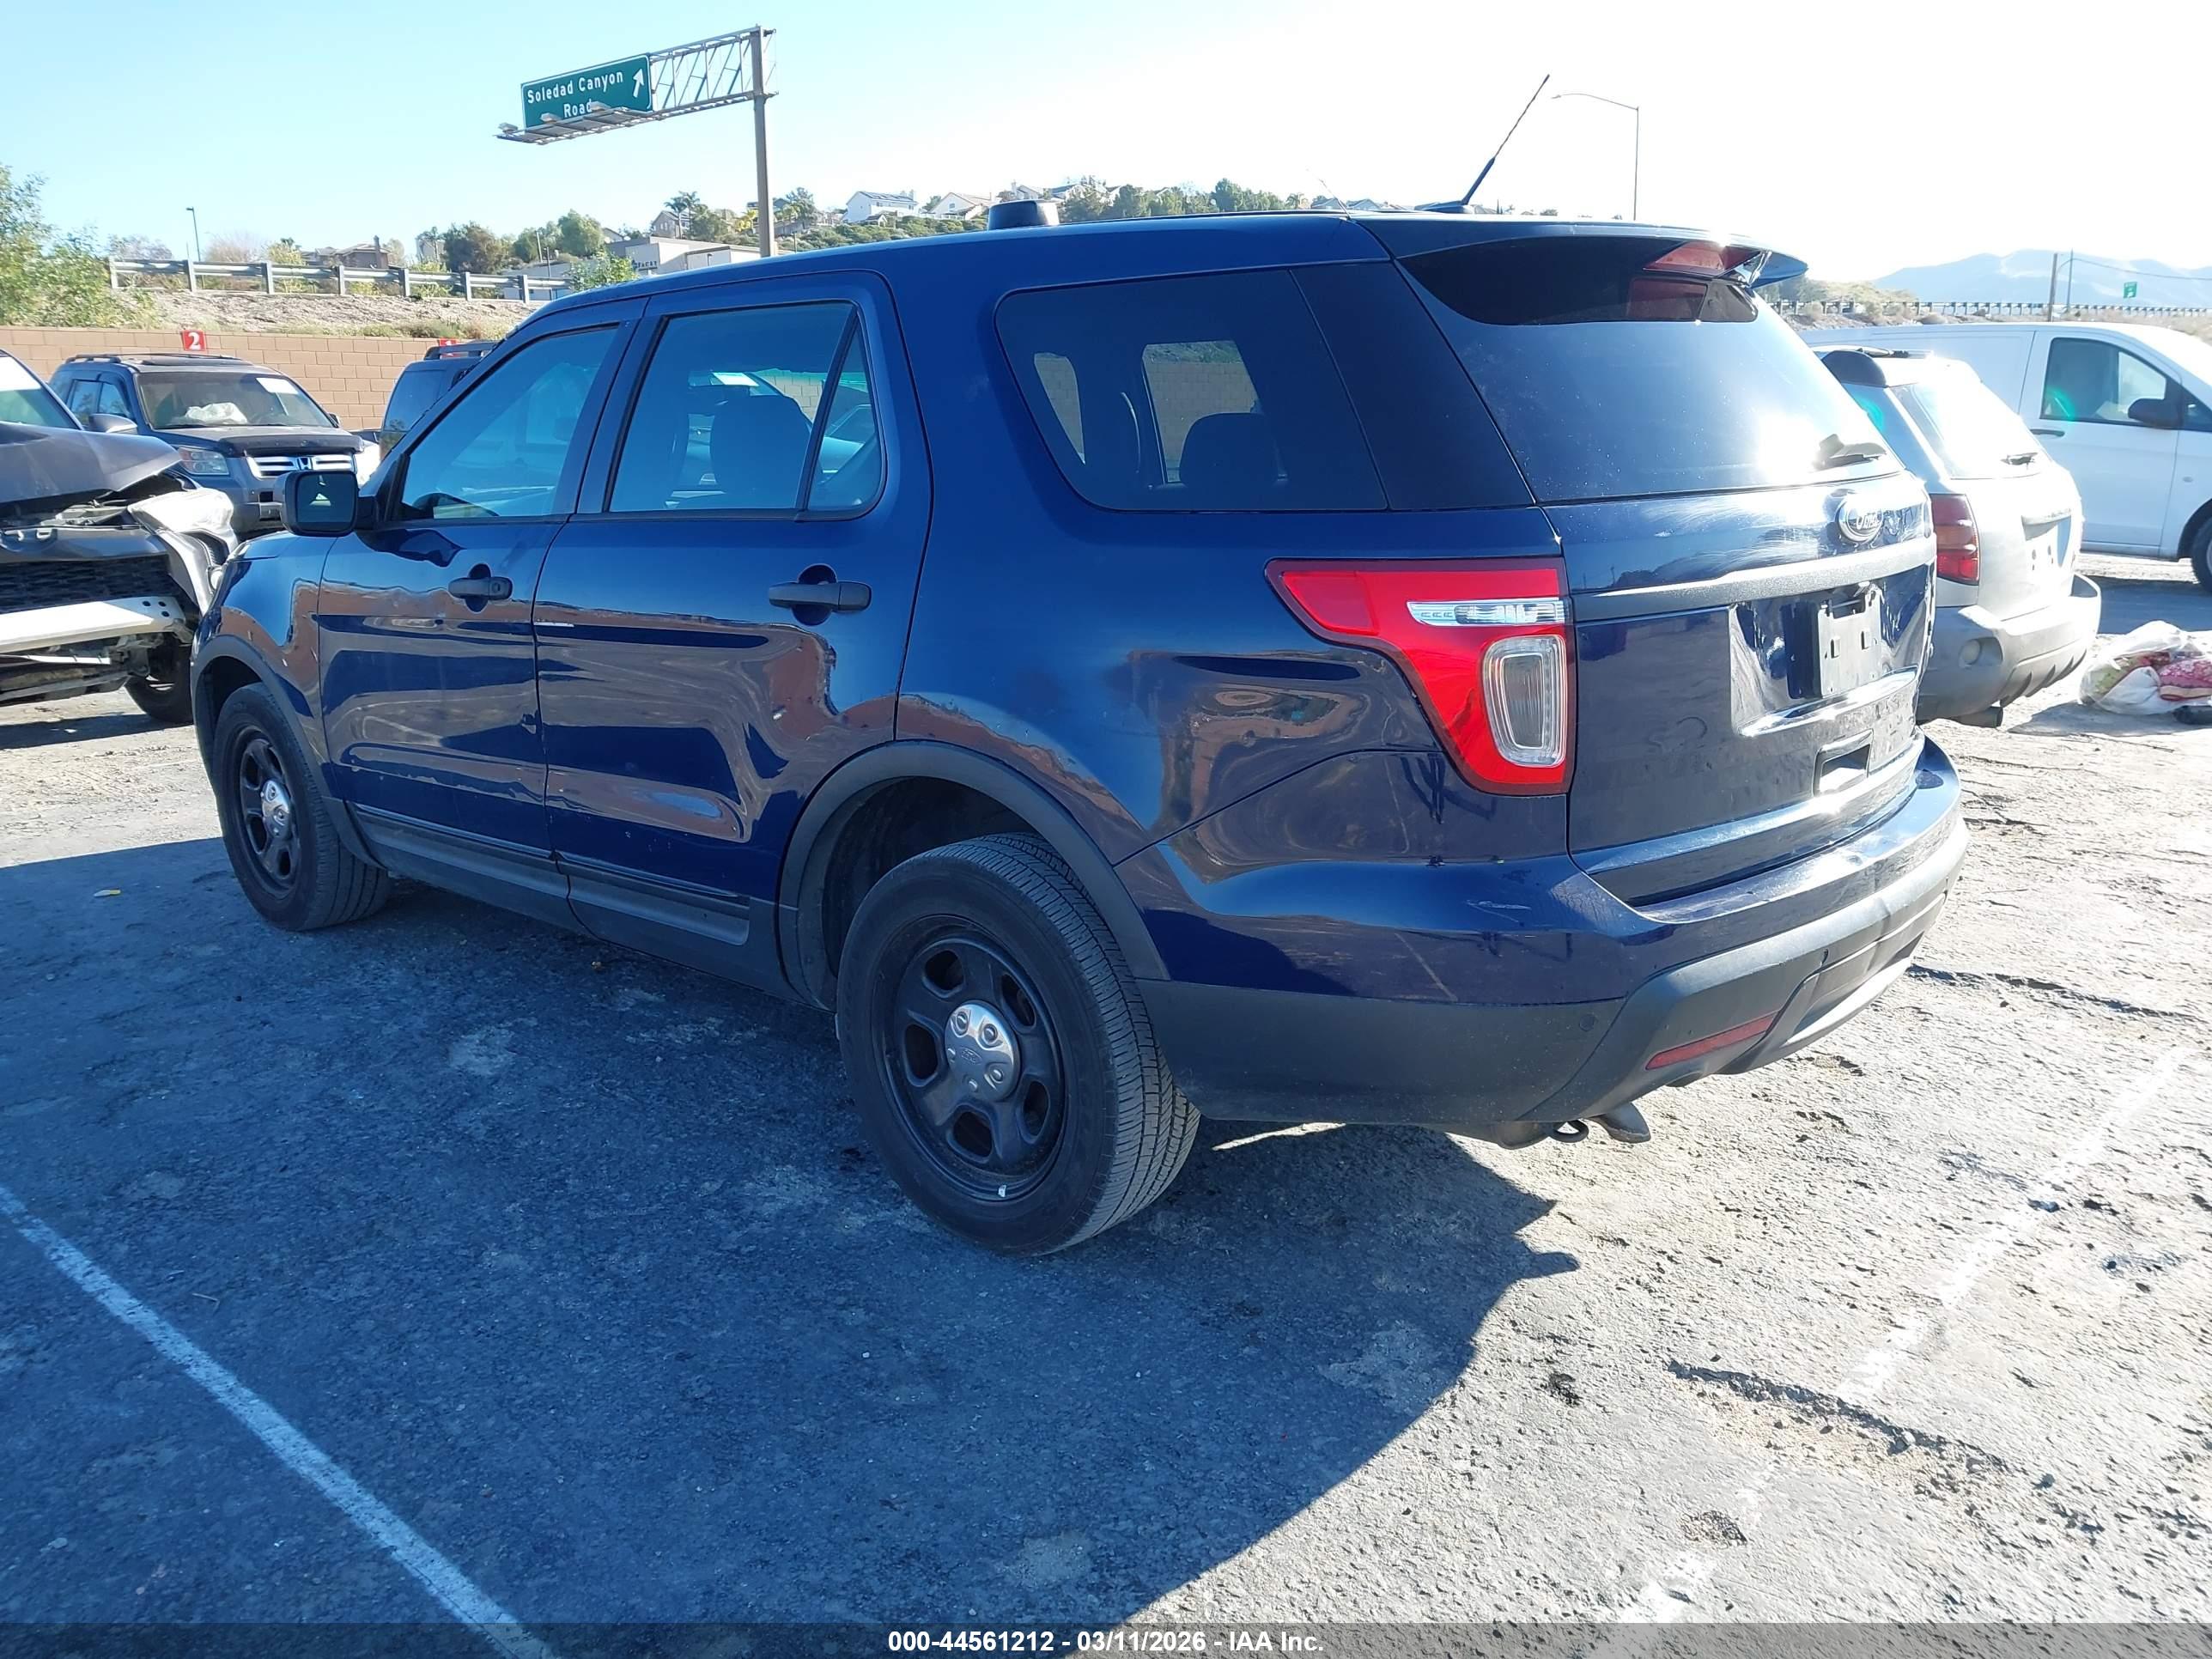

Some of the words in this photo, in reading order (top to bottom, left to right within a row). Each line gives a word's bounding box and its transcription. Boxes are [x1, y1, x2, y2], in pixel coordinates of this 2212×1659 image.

[527, 80, 574, 104] Soledad
[578, 71, 623, 93] Canyon
[563, 99, 592, 118] Road
[188, 331, 201, 349] 2
